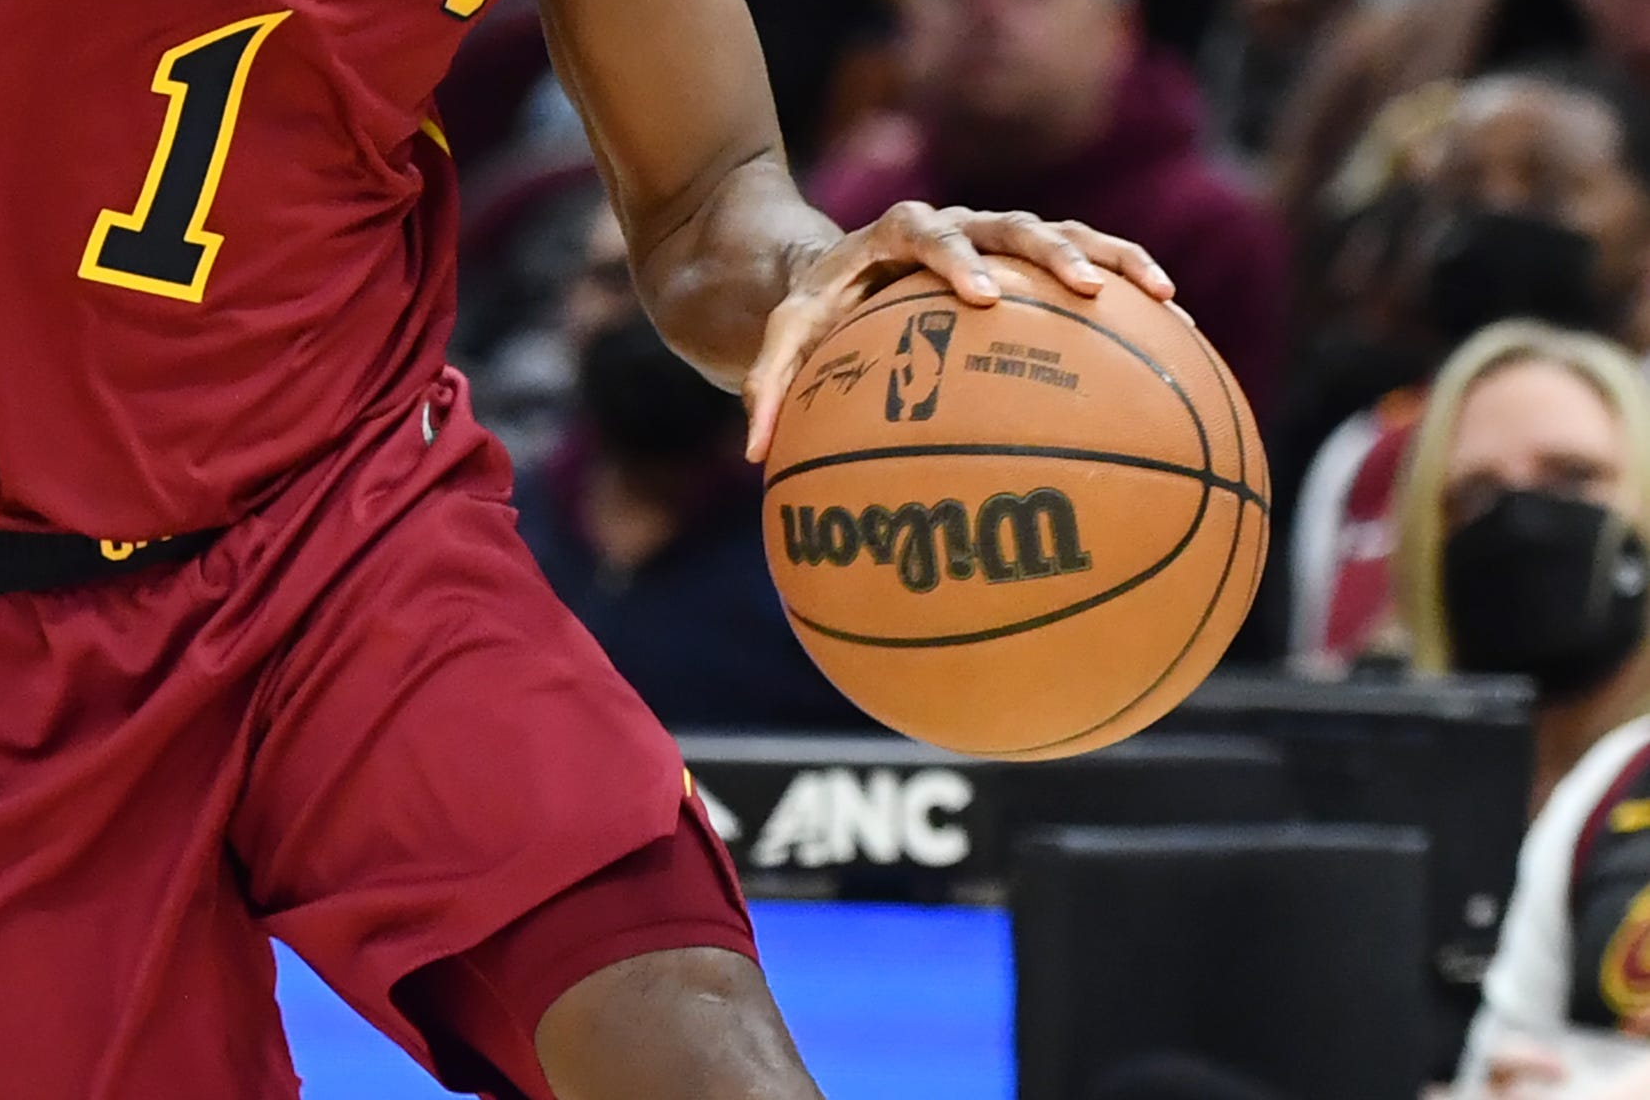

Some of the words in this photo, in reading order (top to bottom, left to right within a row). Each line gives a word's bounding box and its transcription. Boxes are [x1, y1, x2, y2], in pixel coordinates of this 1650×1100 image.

[78, 10, 294, 303] 1
[780, 486, 1092, 593] Wilson
[751, 766, 974, 868] ANC
